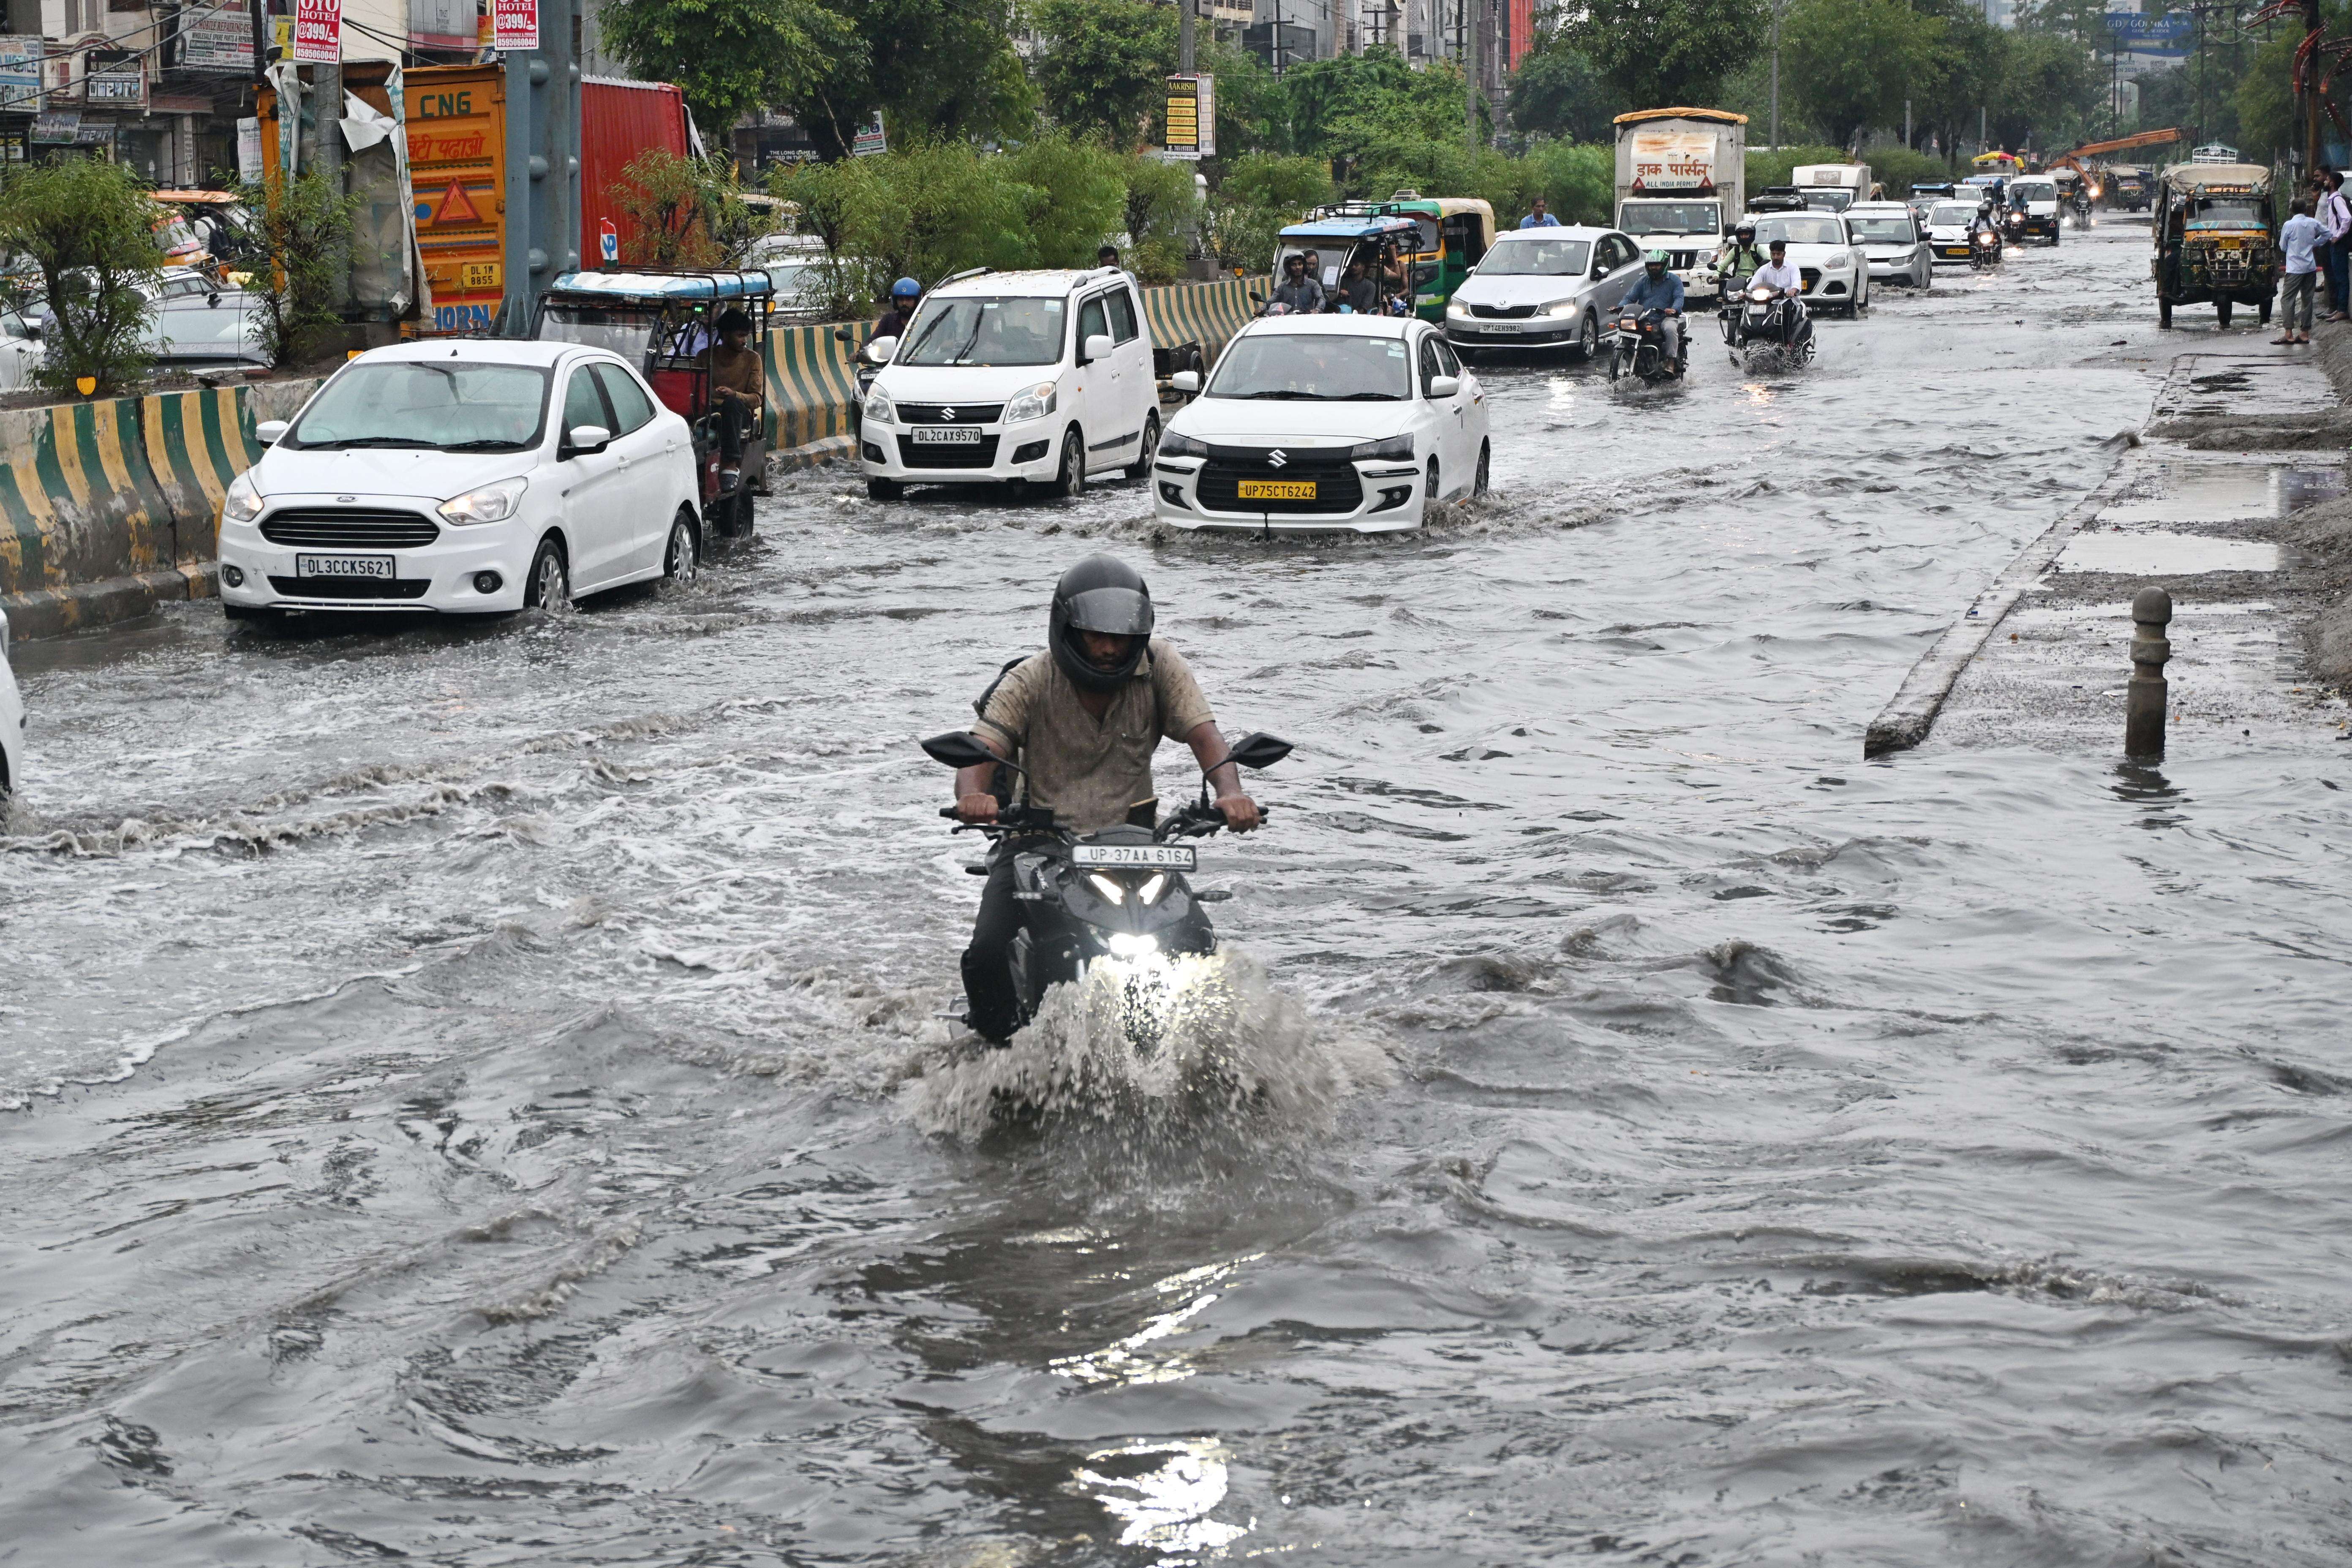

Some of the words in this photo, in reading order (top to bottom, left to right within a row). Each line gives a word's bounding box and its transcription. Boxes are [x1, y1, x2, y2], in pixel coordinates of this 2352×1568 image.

[300, 0, 339, 12] OYO
[498, 3, 534, 11] HOTEL
[300, 10, 338, 22] HOTEL
[497, 14, 531, 30] @399/-
[2131, 19, 2170, 28] GOKA
[297, 21, 333, 41] @399/-
[498, 38, 536, 46] 8595060044
[297, 48, 337, 61] 8595060044
[1168, 82, 1196, 91] AAKRISHI
[420, 91, 471, 118] CNG
[1637, 163, 1662, 177] डाक
[471, 266, 481, 275] DL
[484, 265, 493, 274] 1M
[471, 275, 493, 286] 8855
[919, 431, 979, 441] DL2CAX9570
[1246, 485, 1315, 498] UP75CT6242
[308, 559, 391, 575] DL3CCK5621
